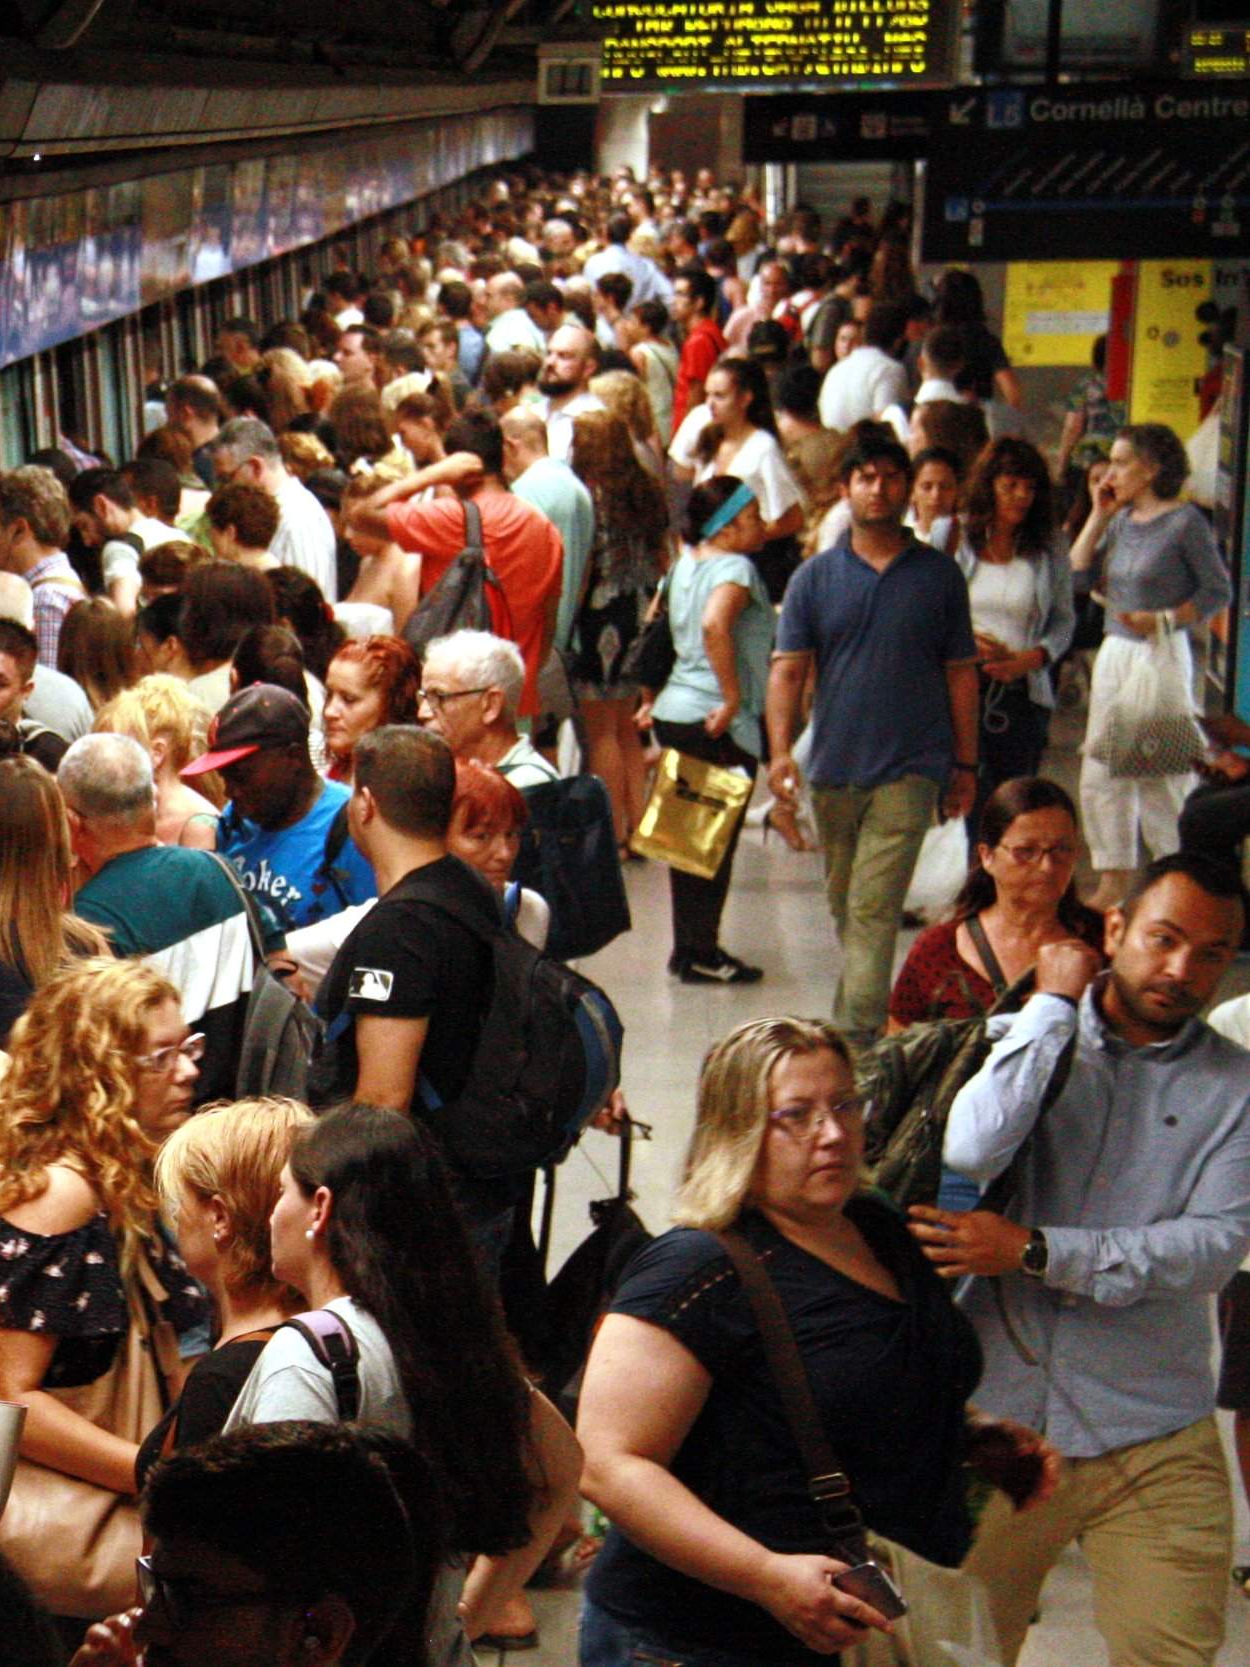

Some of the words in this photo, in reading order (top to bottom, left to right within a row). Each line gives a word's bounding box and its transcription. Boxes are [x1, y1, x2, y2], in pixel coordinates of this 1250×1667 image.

[986, 102, 1022, 128] L5
[1030, 97, 1146, 121] Cornellà
[1154, 94, 1249, 120] Centre
